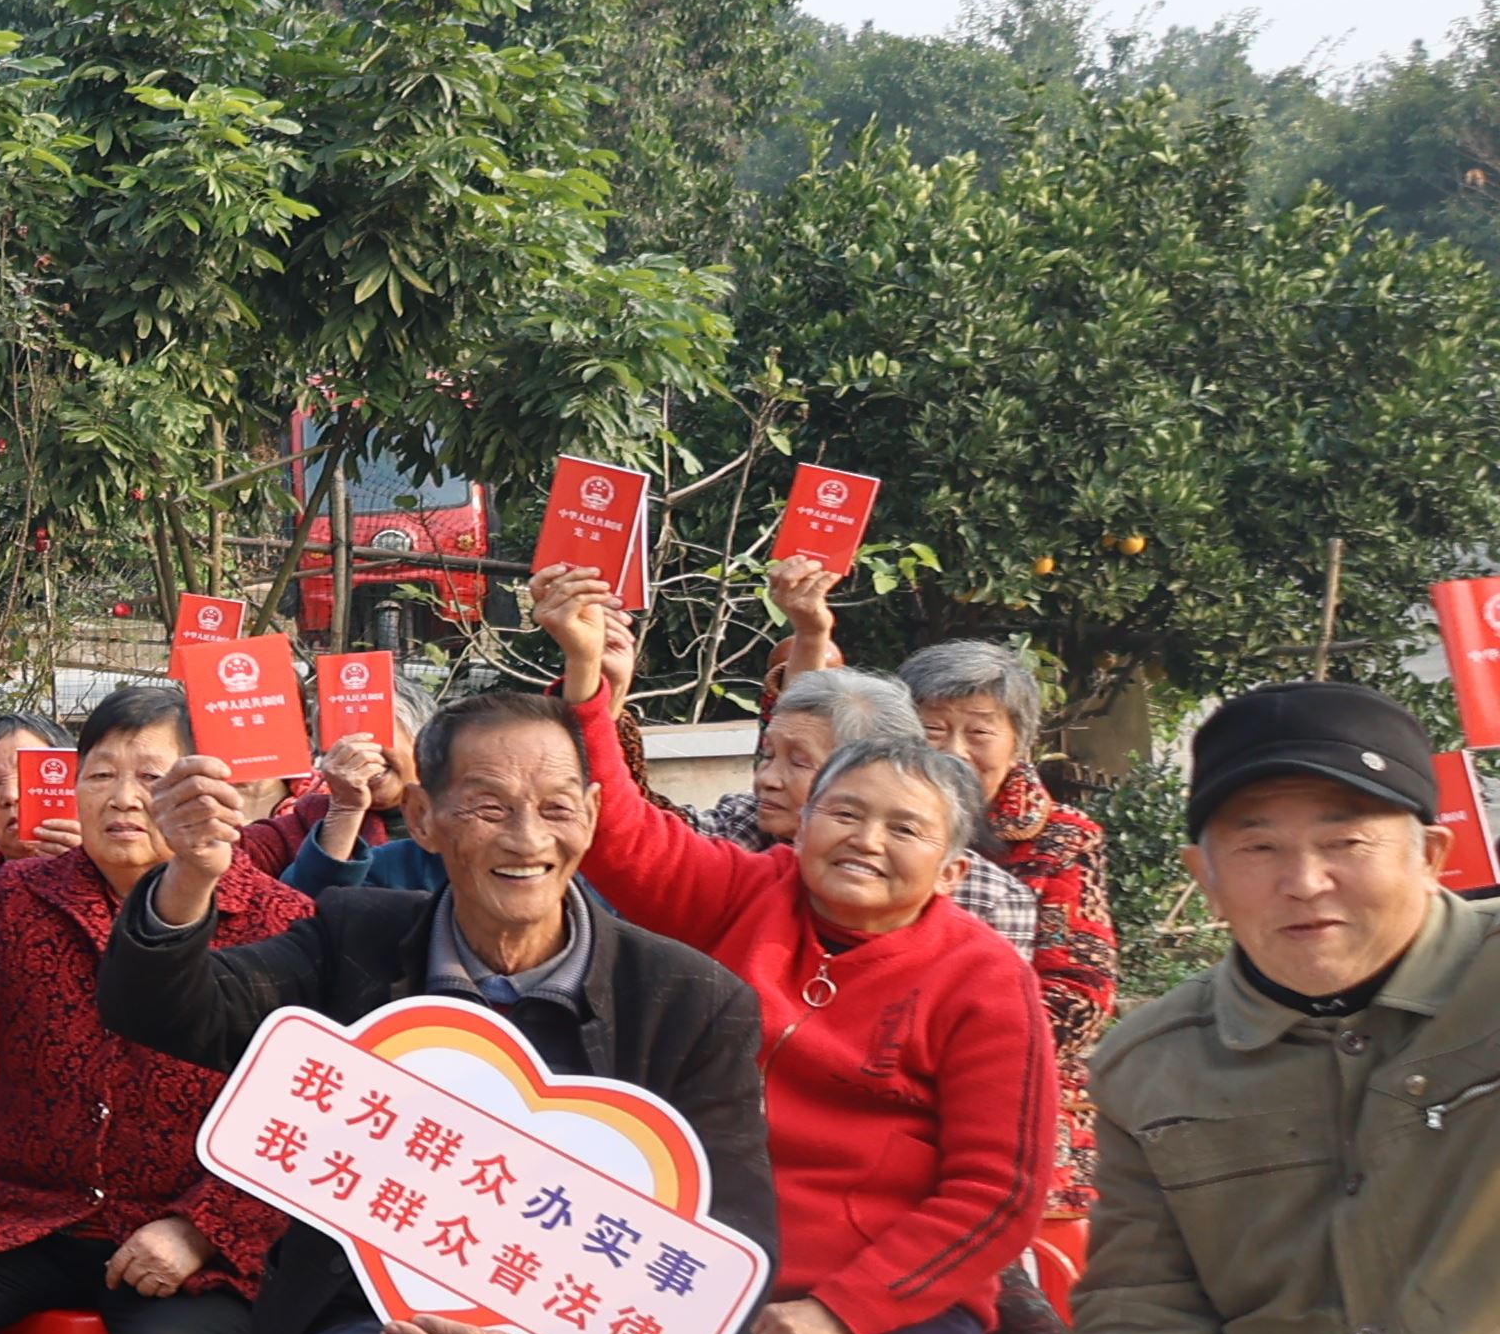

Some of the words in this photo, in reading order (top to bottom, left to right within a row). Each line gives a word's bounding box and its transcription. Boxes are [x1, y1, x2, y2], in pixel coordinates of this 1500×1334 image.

[290, 1057, 707, 1298] 我为群众办实事
